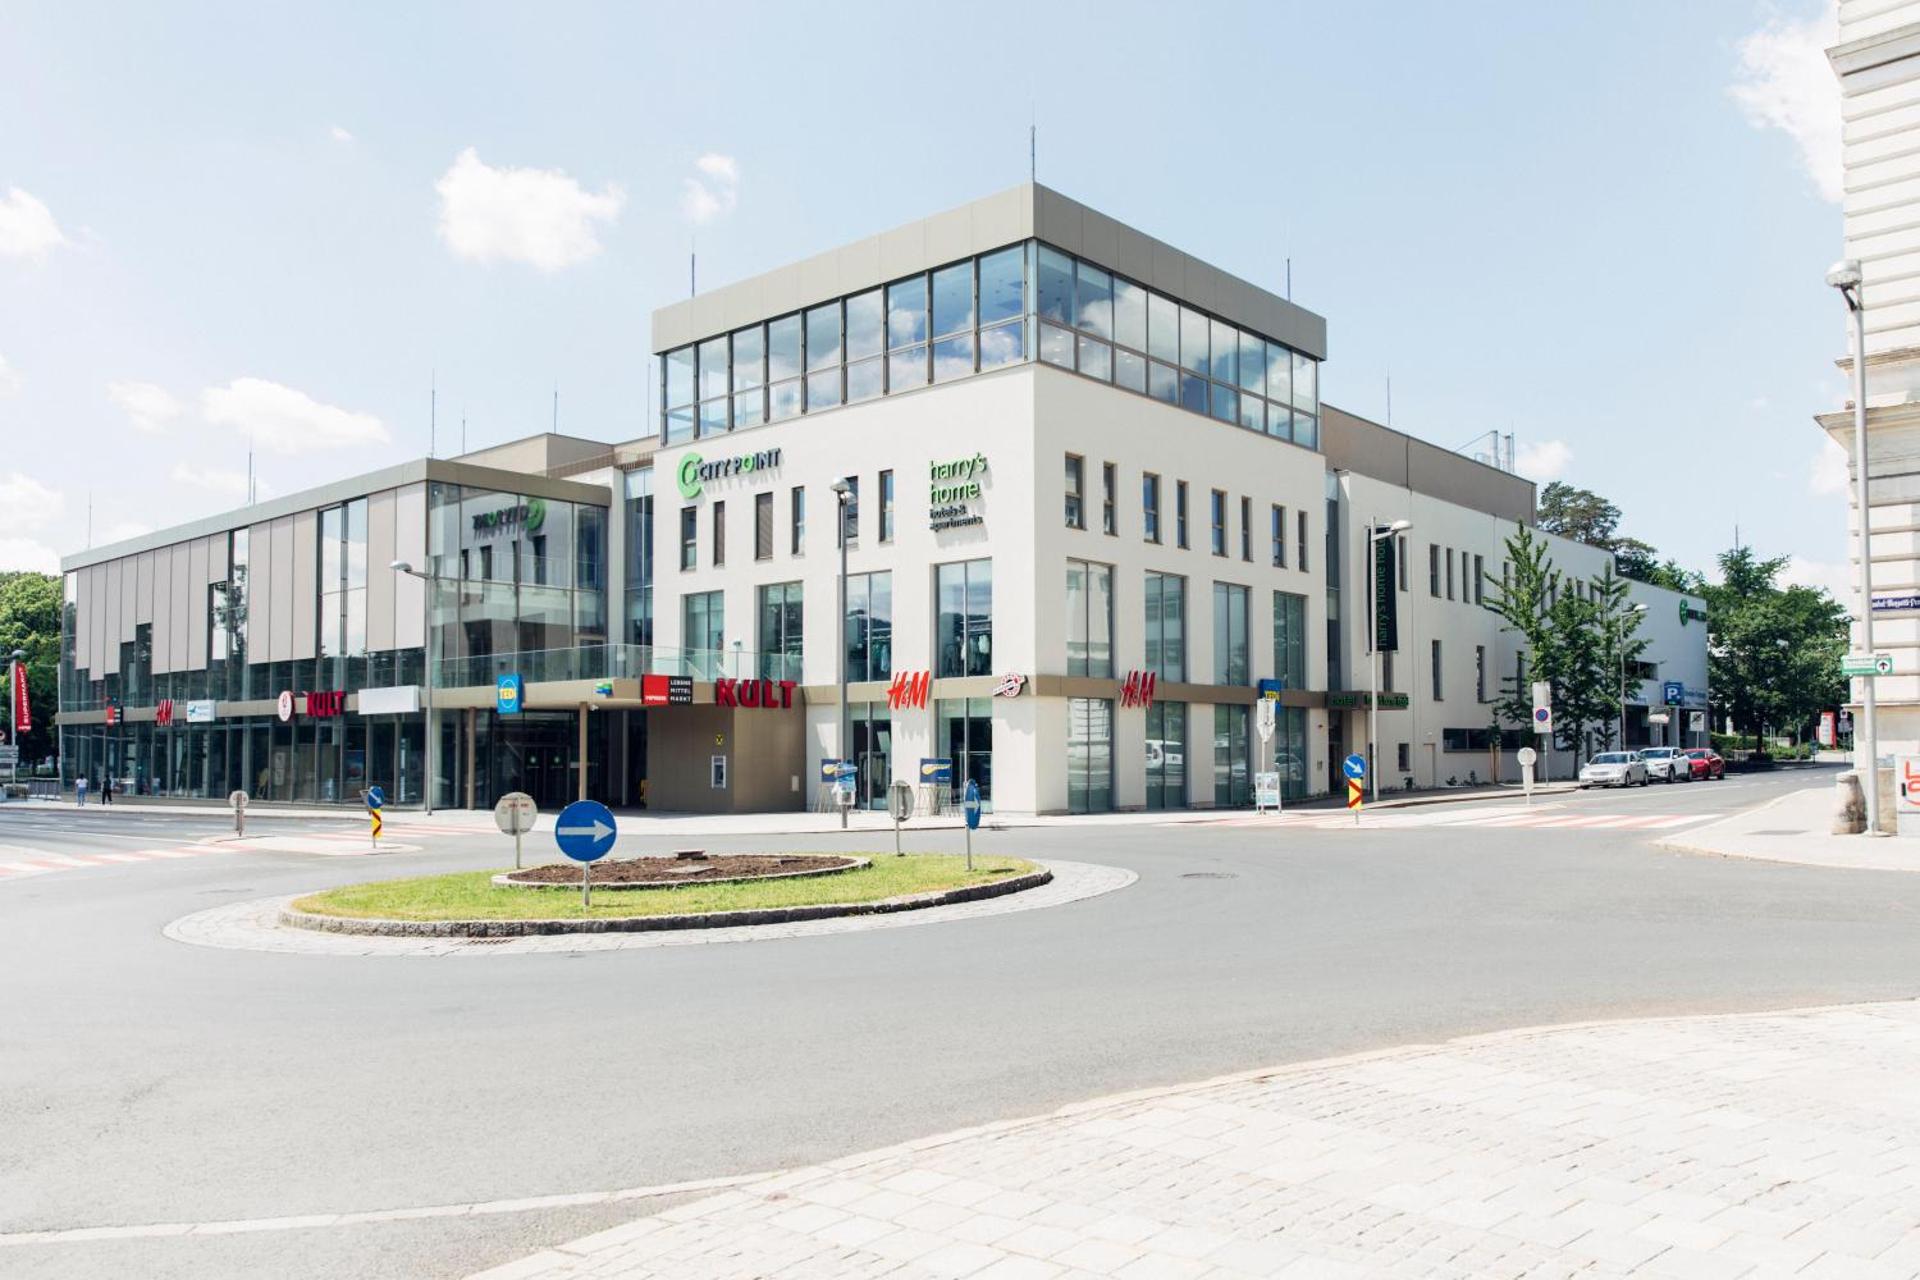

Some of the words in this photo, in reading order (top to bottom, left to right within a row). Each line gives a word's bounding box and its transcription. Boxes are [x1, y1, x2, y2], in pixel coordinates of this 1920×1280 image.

[700, 458, 731, 481] CITY
[733, 448, 781, 475] POINT
[930, 452, 987, 480] harry's
[930, 483, 980, 504] home
[929, 506, 958, 519] hotels
[1375, 566, 1386, 602] home
[306, 690, 346, 717] KULT
[715, 677, 797, 709] KULT
[887, 670, 930, 710] H&M
[1120, 670, 1155, 710] H&M
